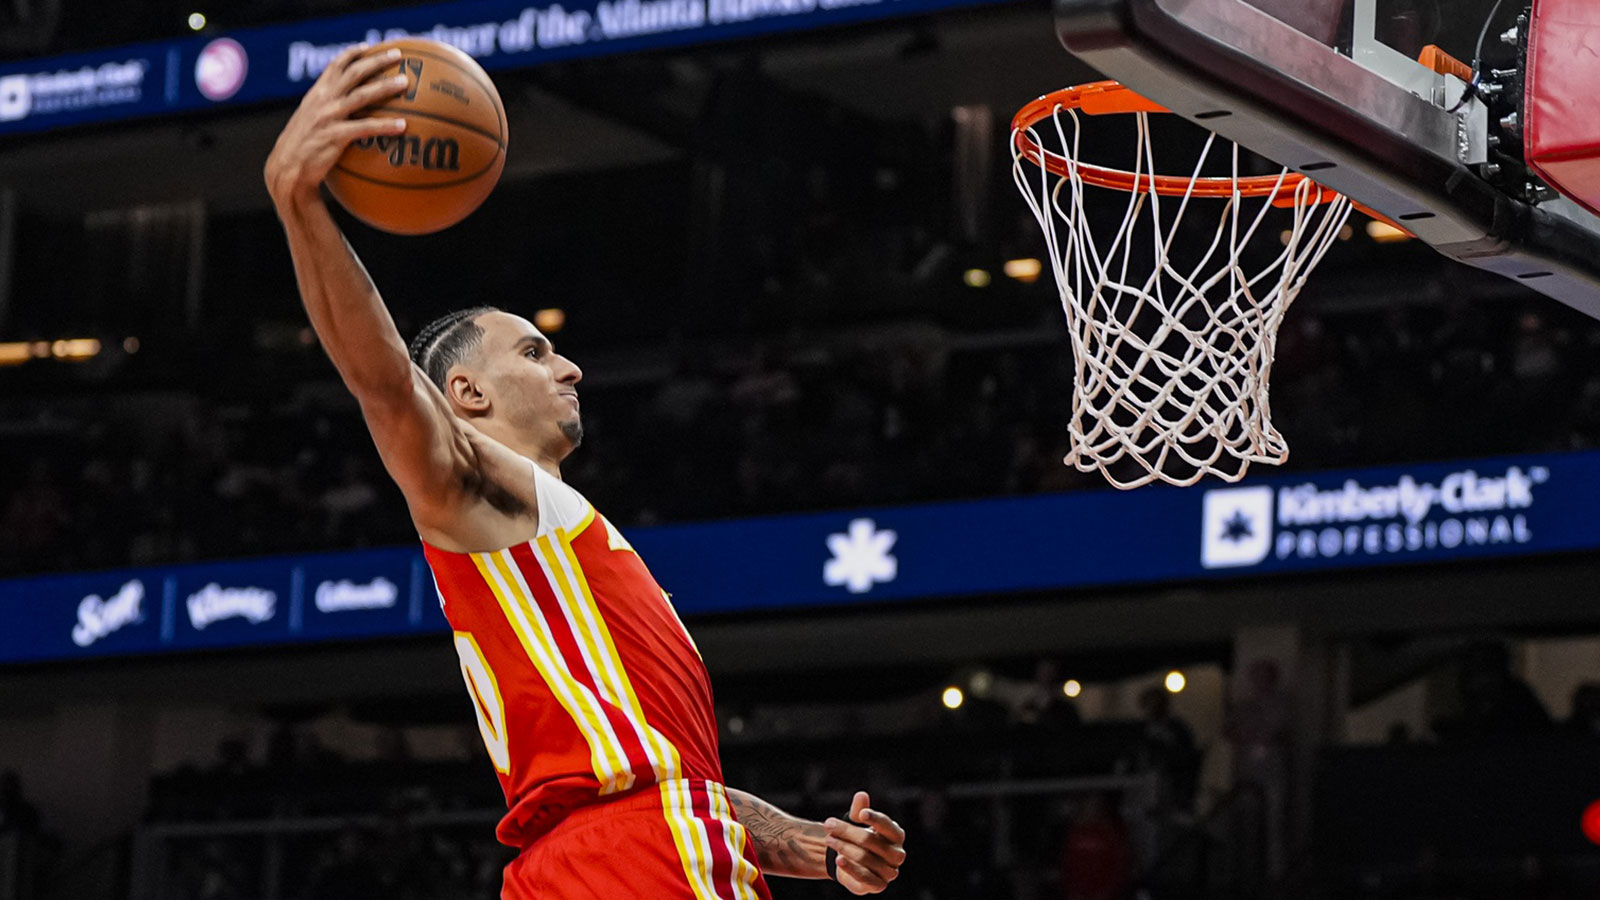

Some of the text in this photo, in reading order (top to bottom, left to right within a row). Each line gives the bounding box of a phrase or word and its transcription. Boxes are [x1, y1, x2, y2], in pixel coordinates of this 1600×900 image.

[499, 8, 537, 53] of
[536, 4, 590, 48] the
[584, 0, 705, 41] Atlanta
[355, 135, 460, 171] Wilso
[1278, 467, 1533, 523] Kimberly-Clark
[1275, 514, 1532, 559] PROFESSIONAL
